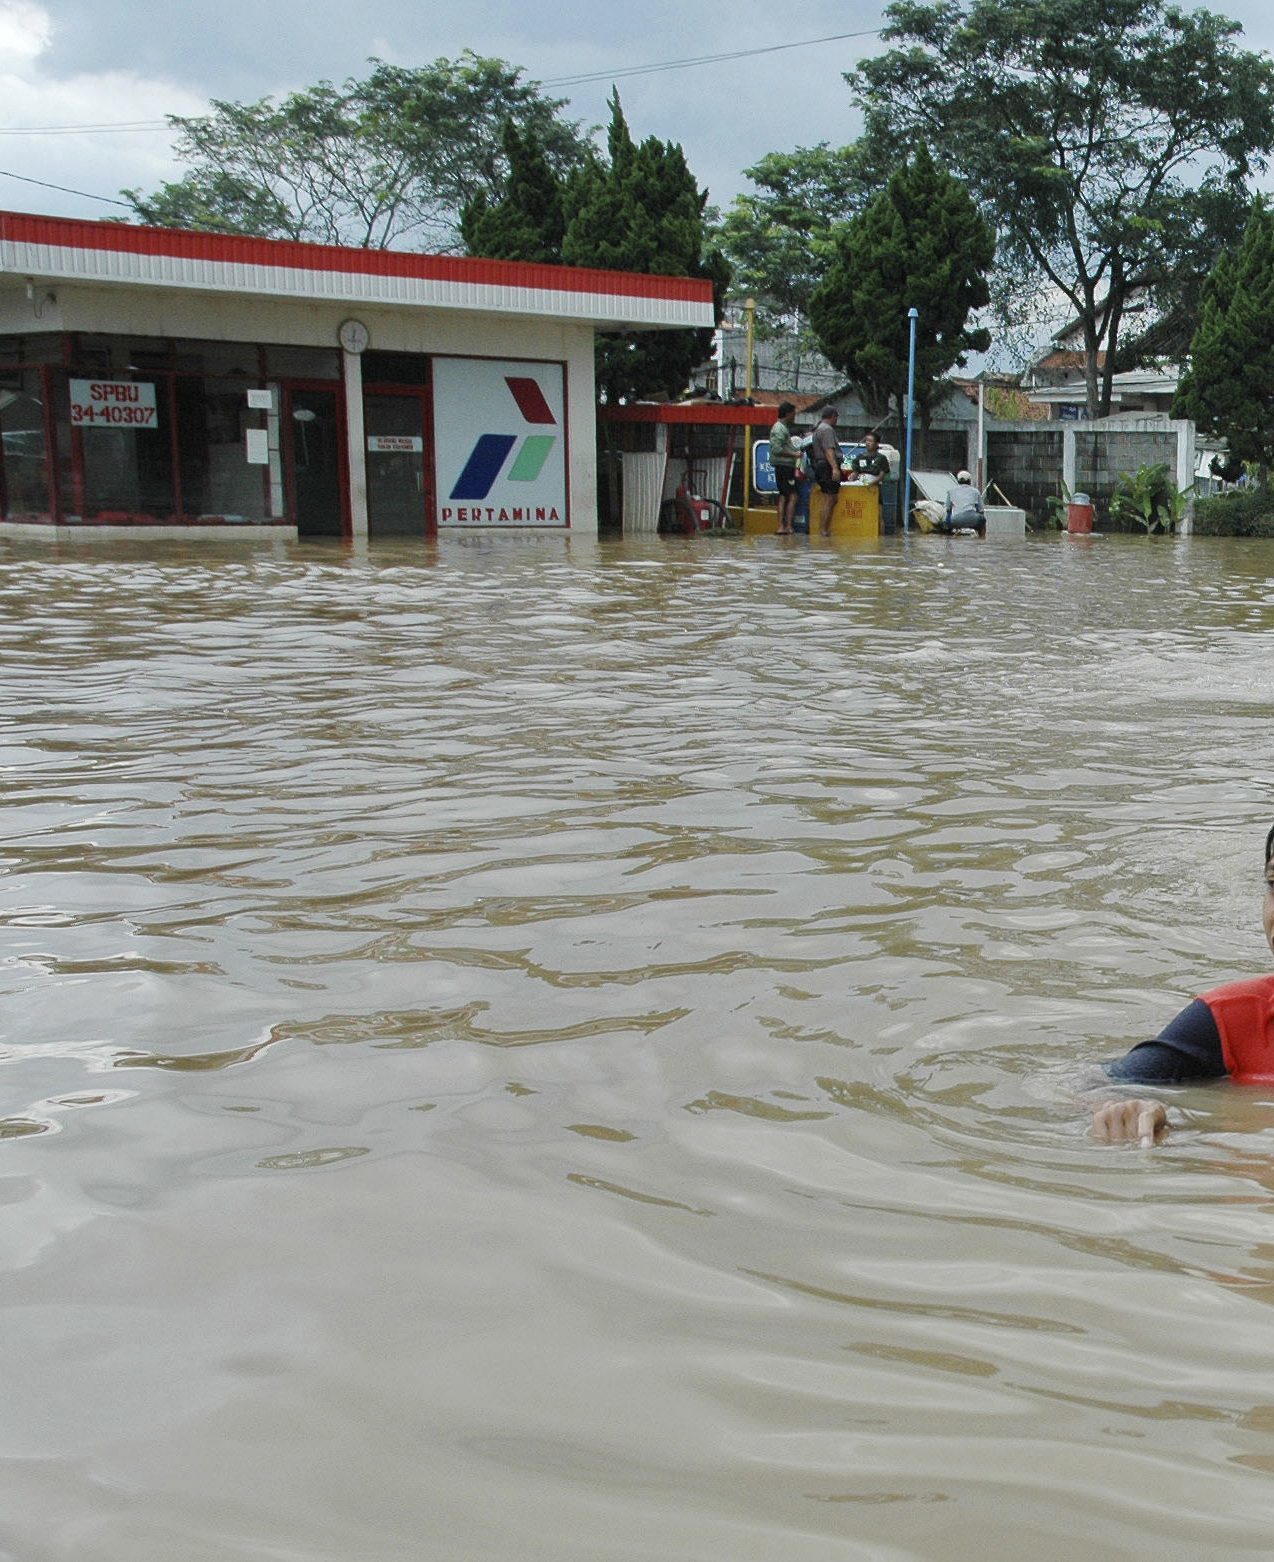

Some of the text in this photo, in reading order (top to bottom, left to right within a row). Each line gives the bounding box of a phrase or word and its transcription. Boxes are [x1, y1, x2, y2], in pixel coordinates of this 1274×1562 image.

[90, 383, 139, 402] SPBU
[71, 404, 155, 424] 34-40307
[441, 507, 560, 521] PERTAMINA
